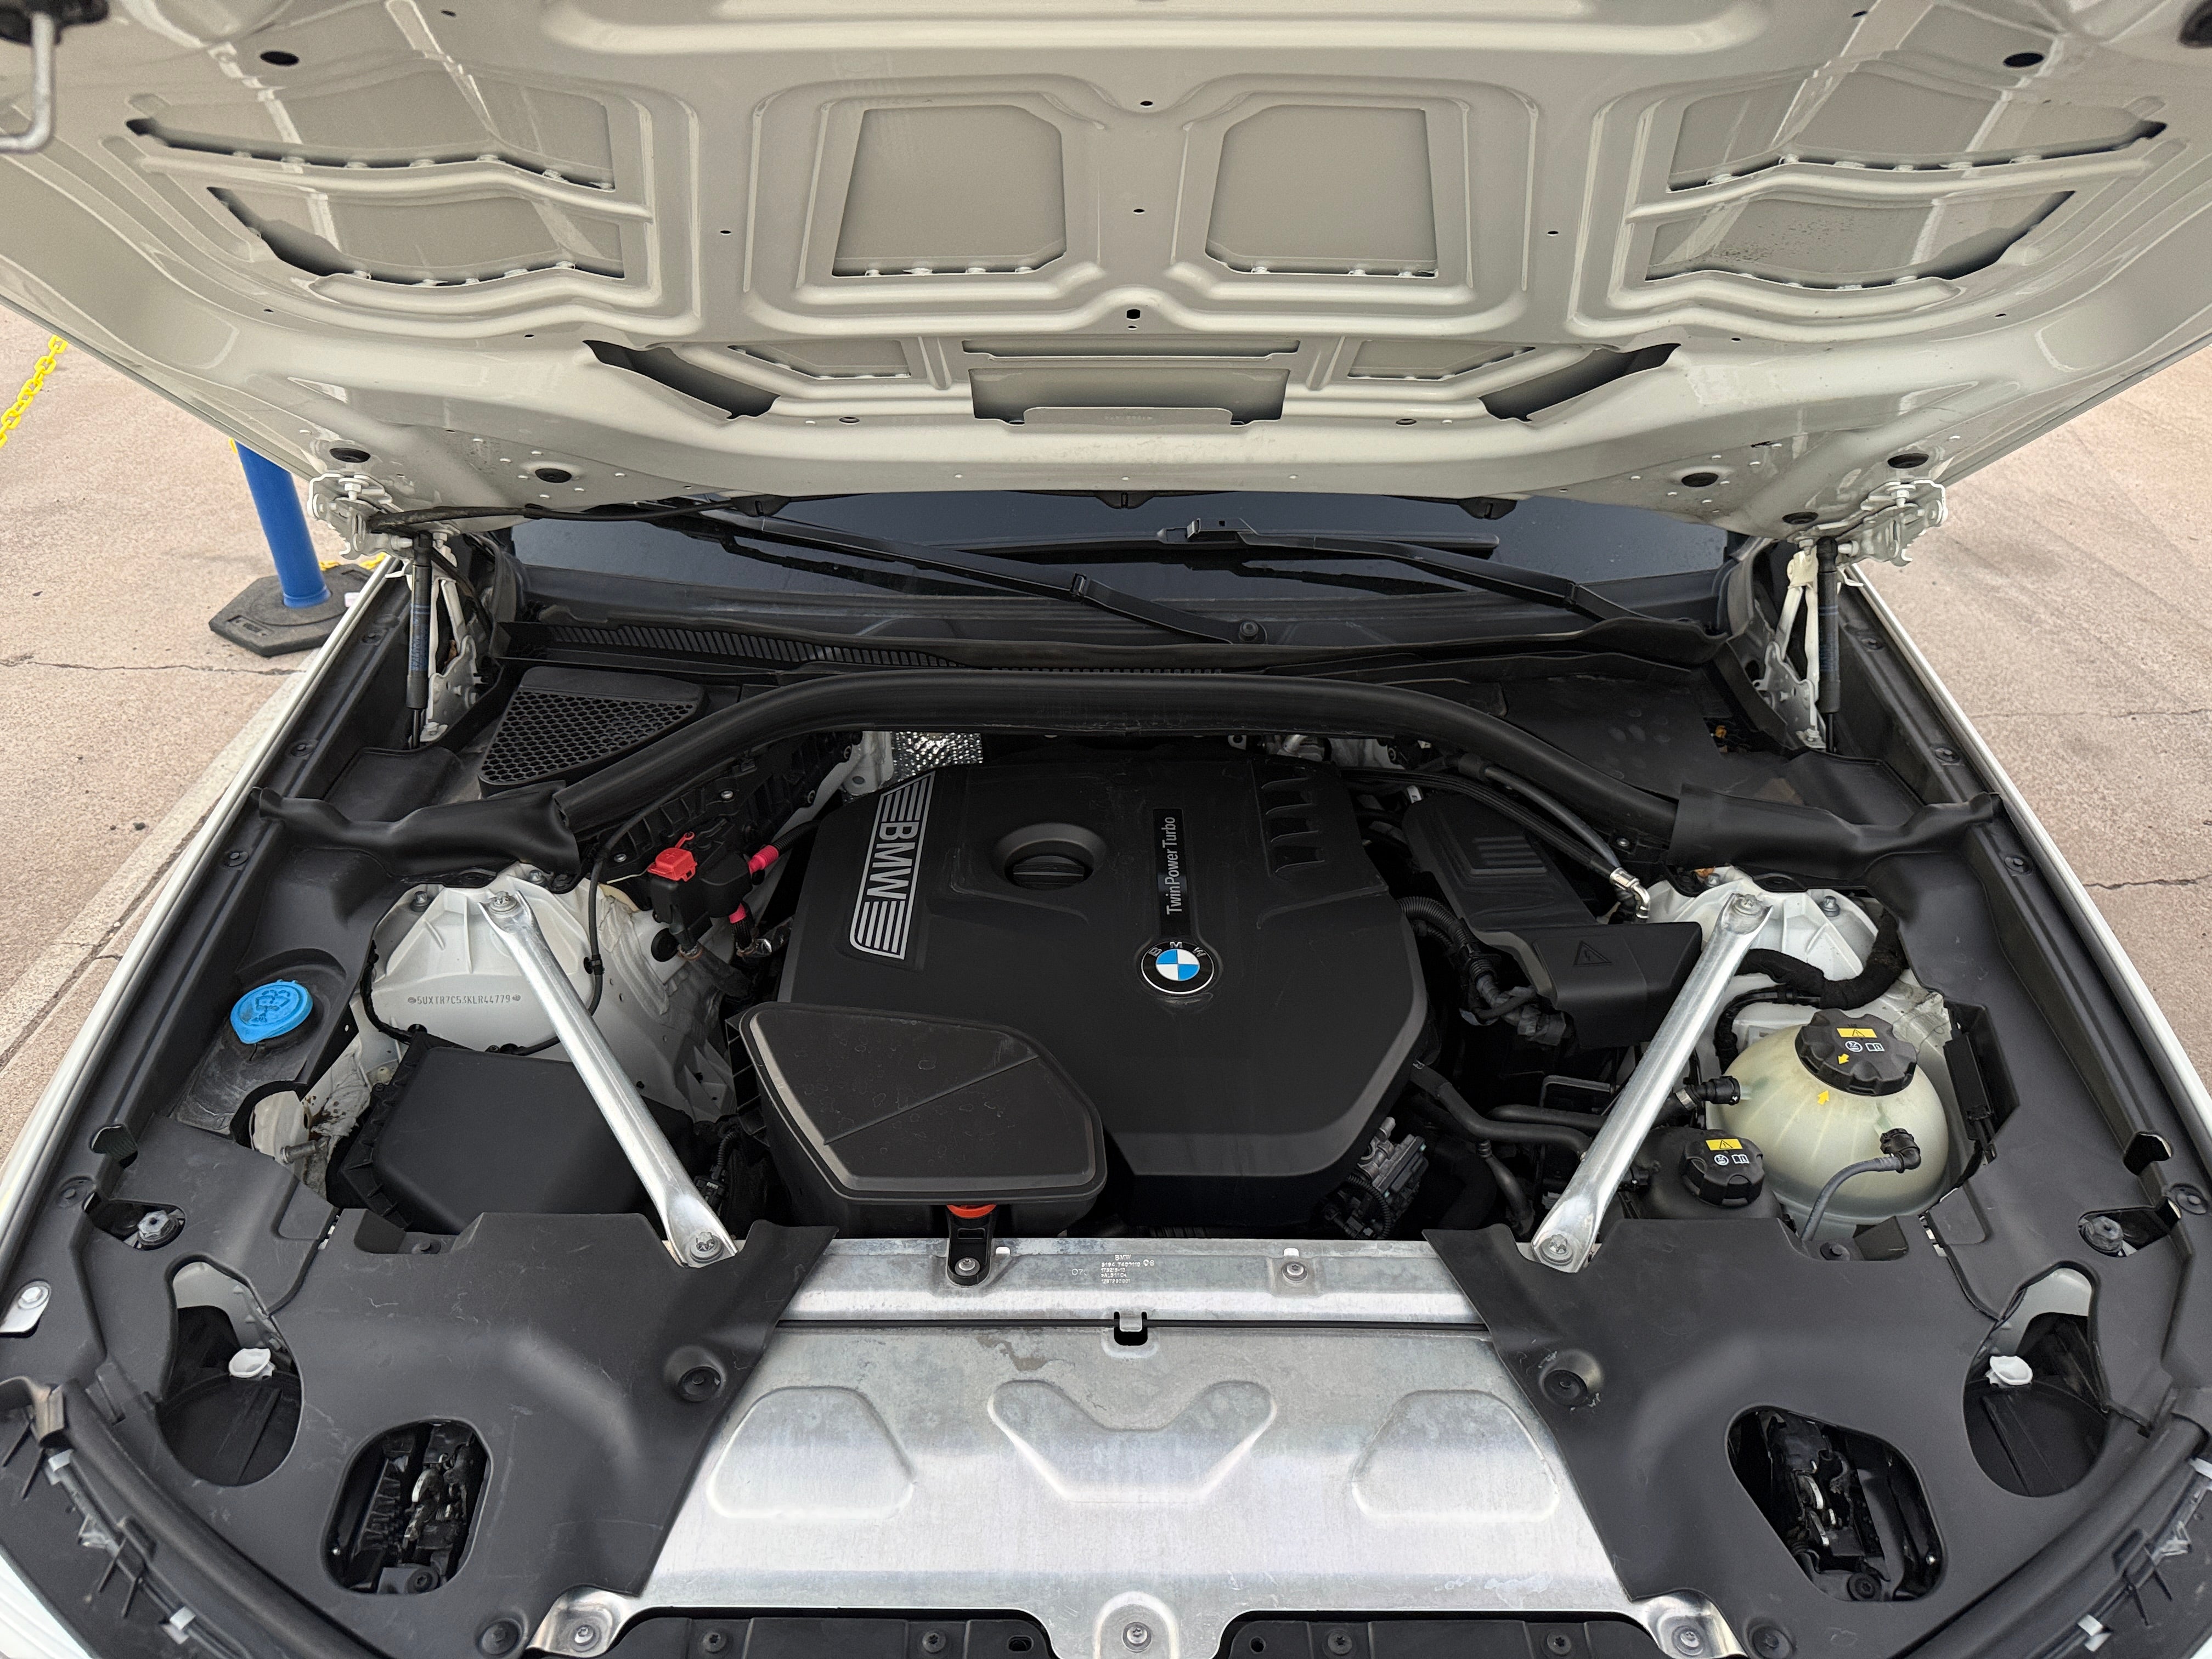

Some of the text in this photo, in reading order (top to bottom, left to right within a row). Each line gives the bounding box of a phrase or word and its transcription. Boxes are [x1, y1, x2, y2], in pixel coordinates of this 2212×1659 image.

[866, 821, 919, 900] BMW
[1161, 816, 1183, 916] TwinPower Turbo
[1148, 941, 1207, 958] BMW
